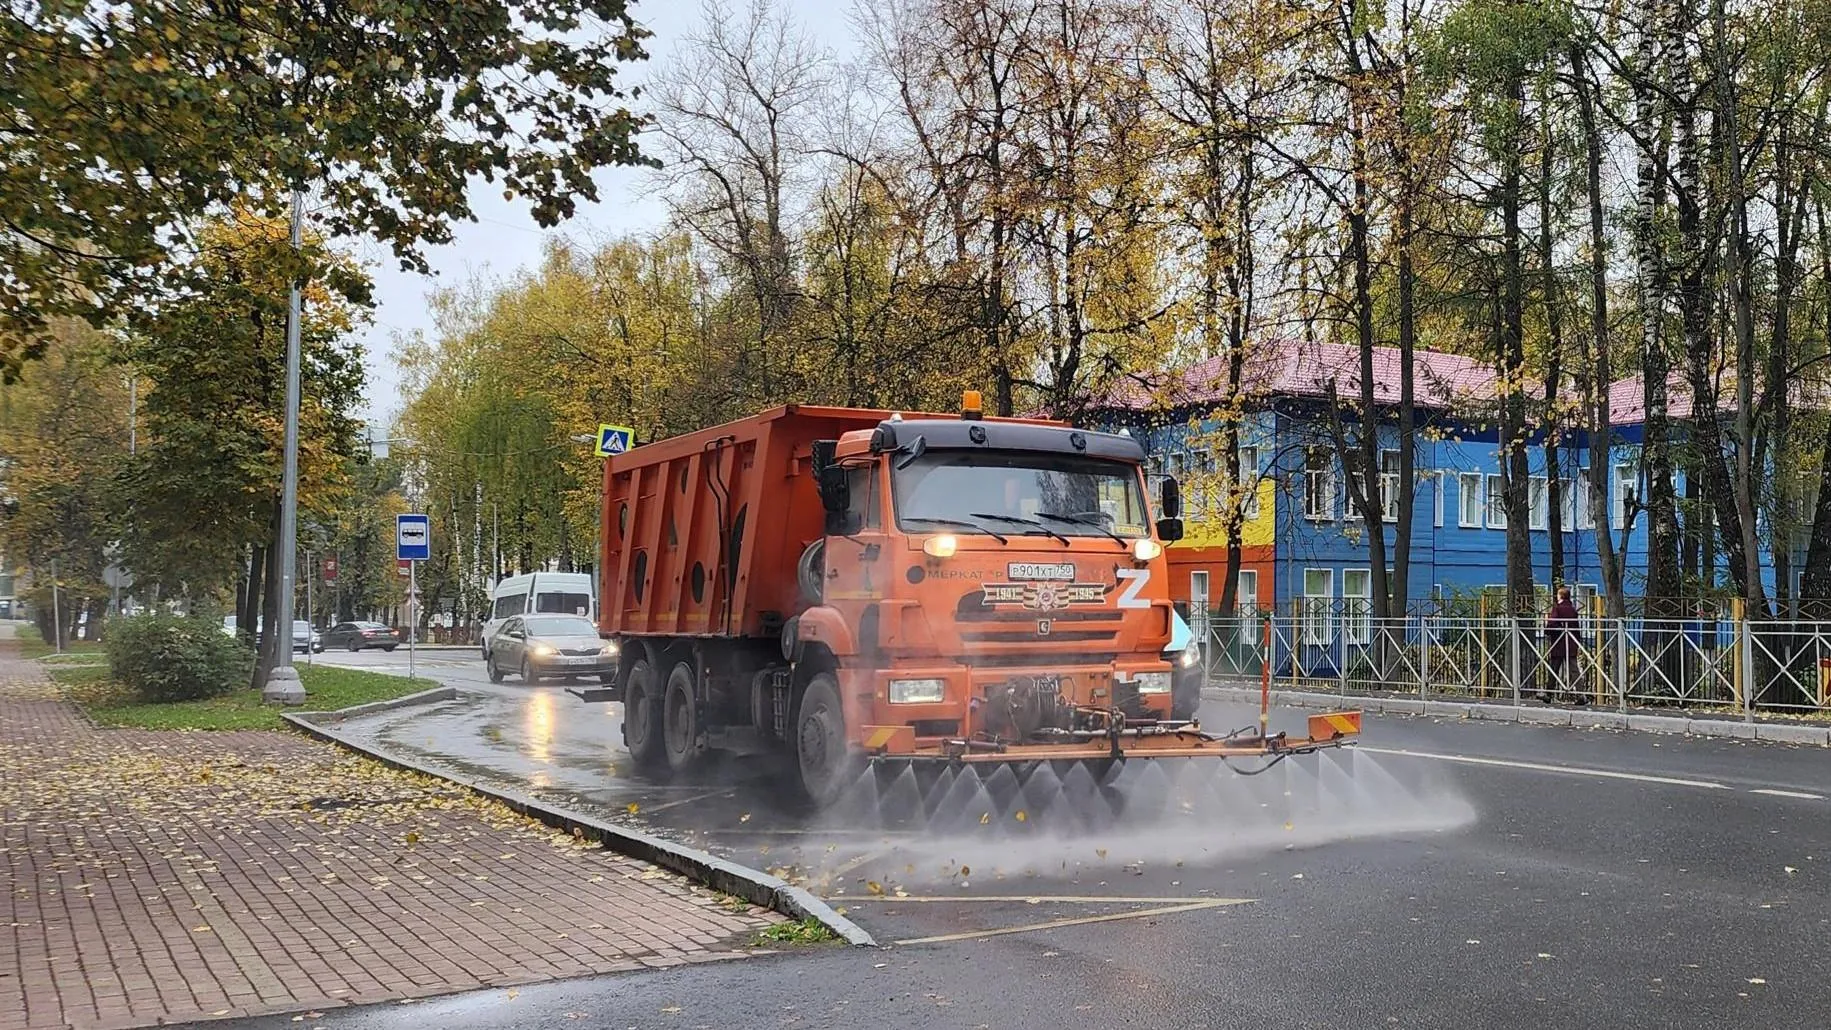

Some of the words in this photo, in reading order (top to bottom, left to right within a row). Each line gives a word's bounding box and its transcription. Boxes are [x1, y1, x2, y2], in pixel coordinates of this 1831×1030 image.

[928, 570, 1003, 579] МЕРКАТР
[996, 588, 1017, 600] 1941
[1075, 588, 1094, 600] 1945
[1116, 568, 1152, 609] Z
